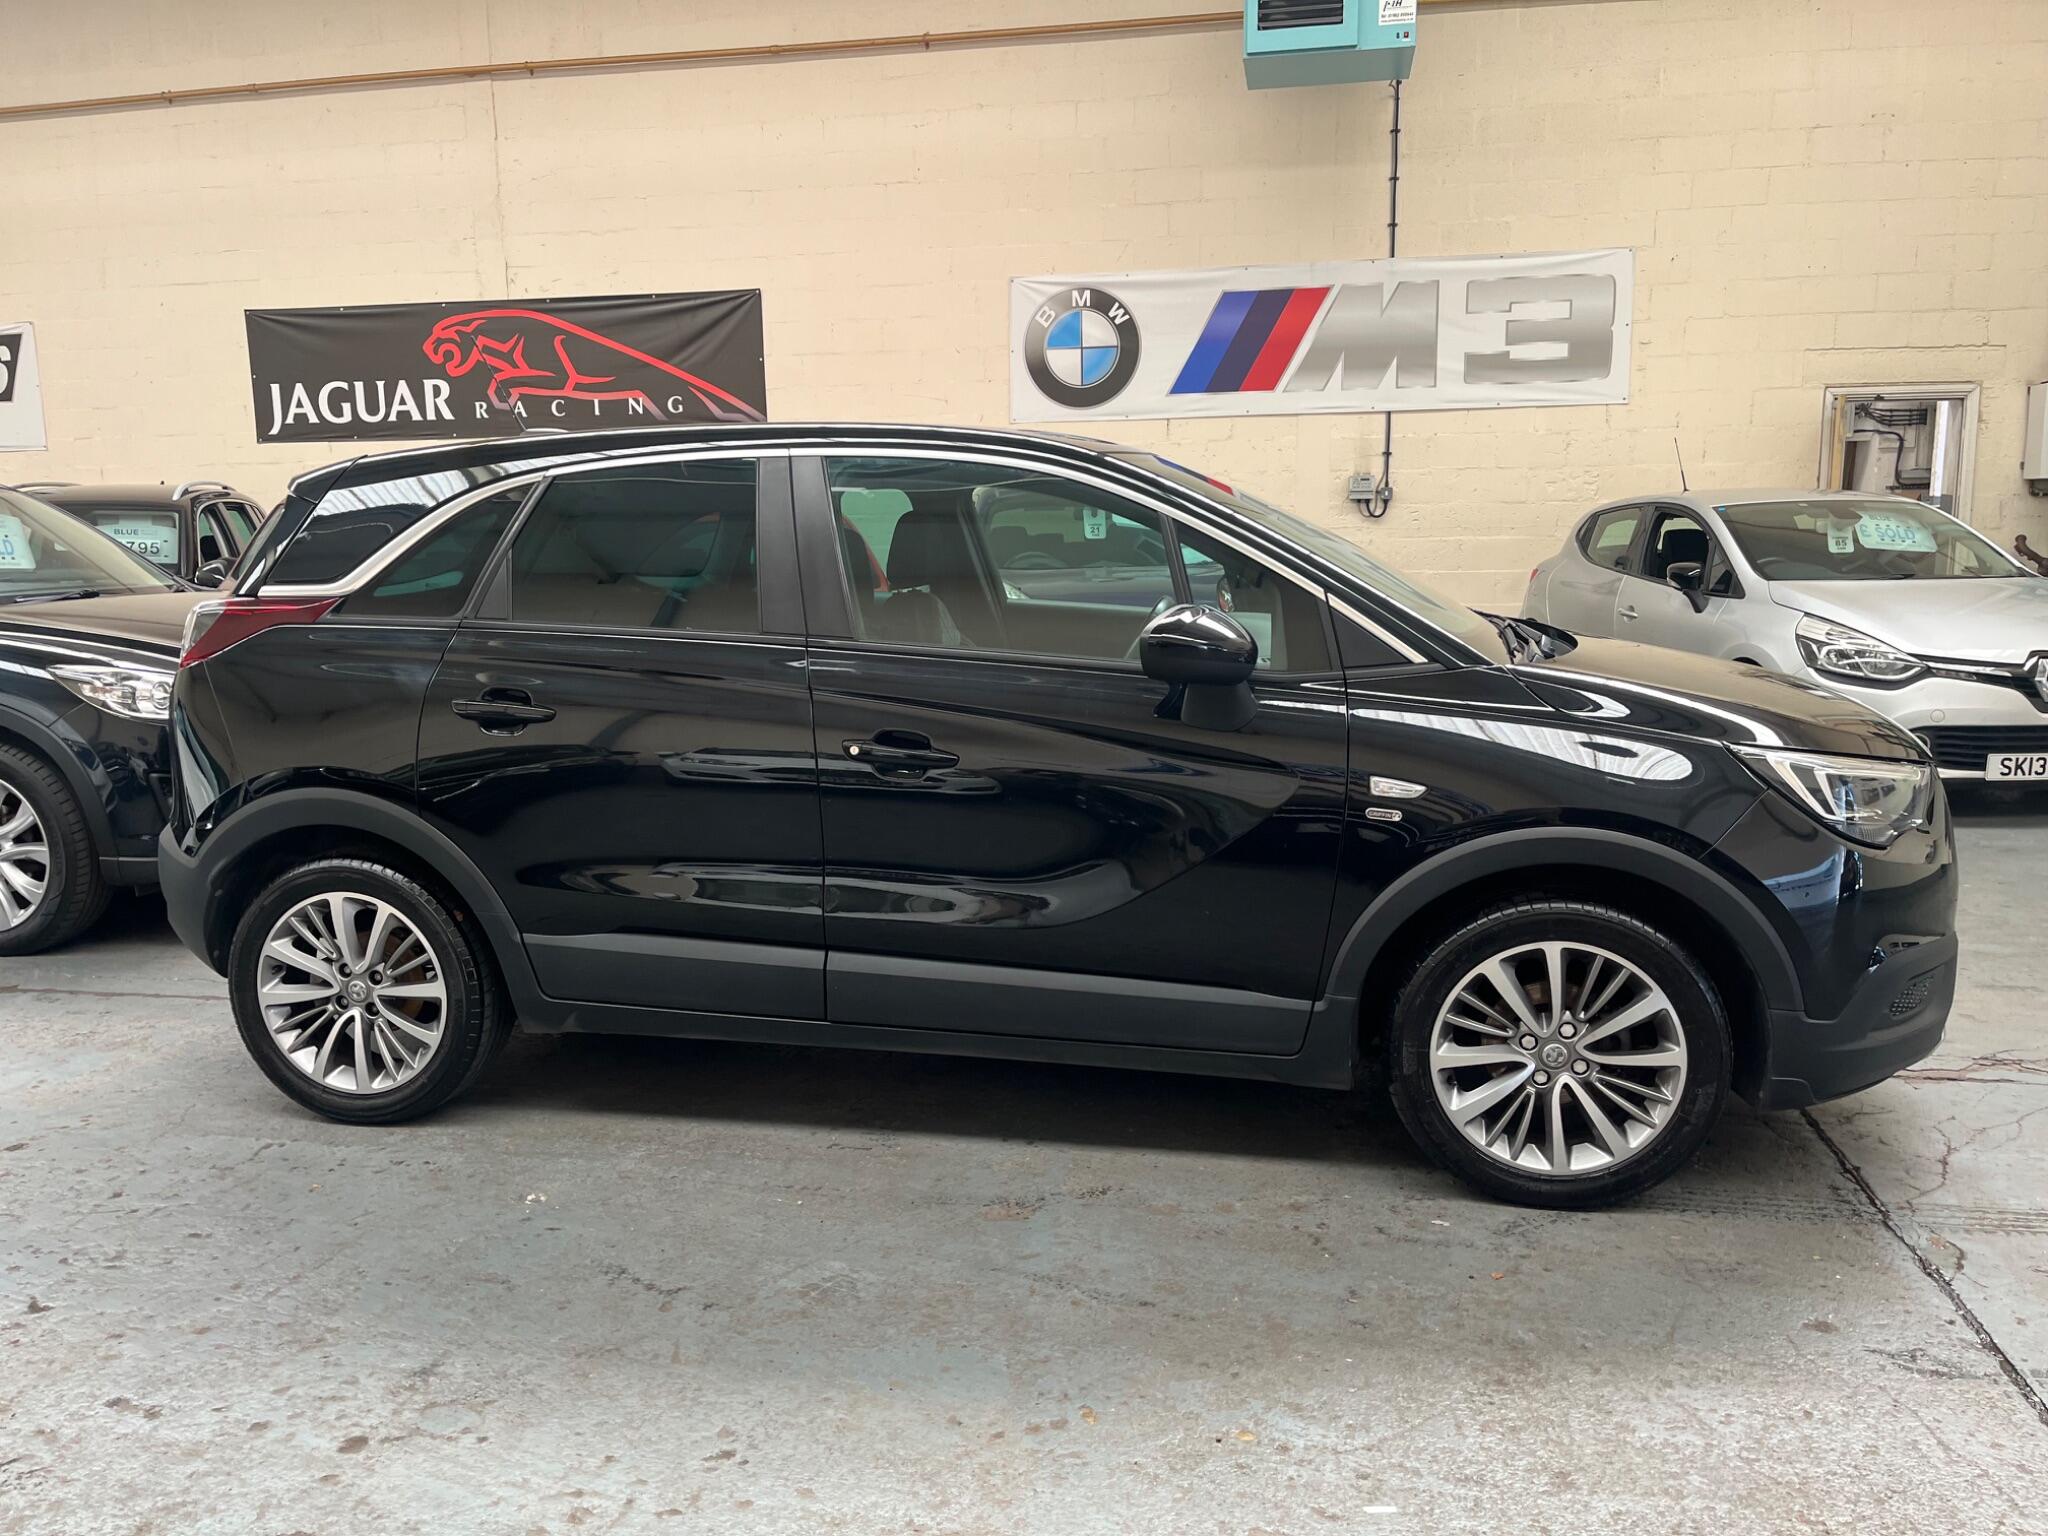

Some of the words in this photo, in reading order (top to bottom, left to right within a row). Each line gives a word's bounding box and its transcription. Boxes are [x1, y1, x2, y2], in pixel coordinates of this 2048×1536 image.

[1034, 288, 1129, 328] BMW
[268, 378, 456, 436] JAGUAR
[474, 394, 685, 420] RACING
[113, 528, 140, 536] BLUE
[1875, 526, 1916, 541] SOLD
[126, 540, 160, 555] 795
